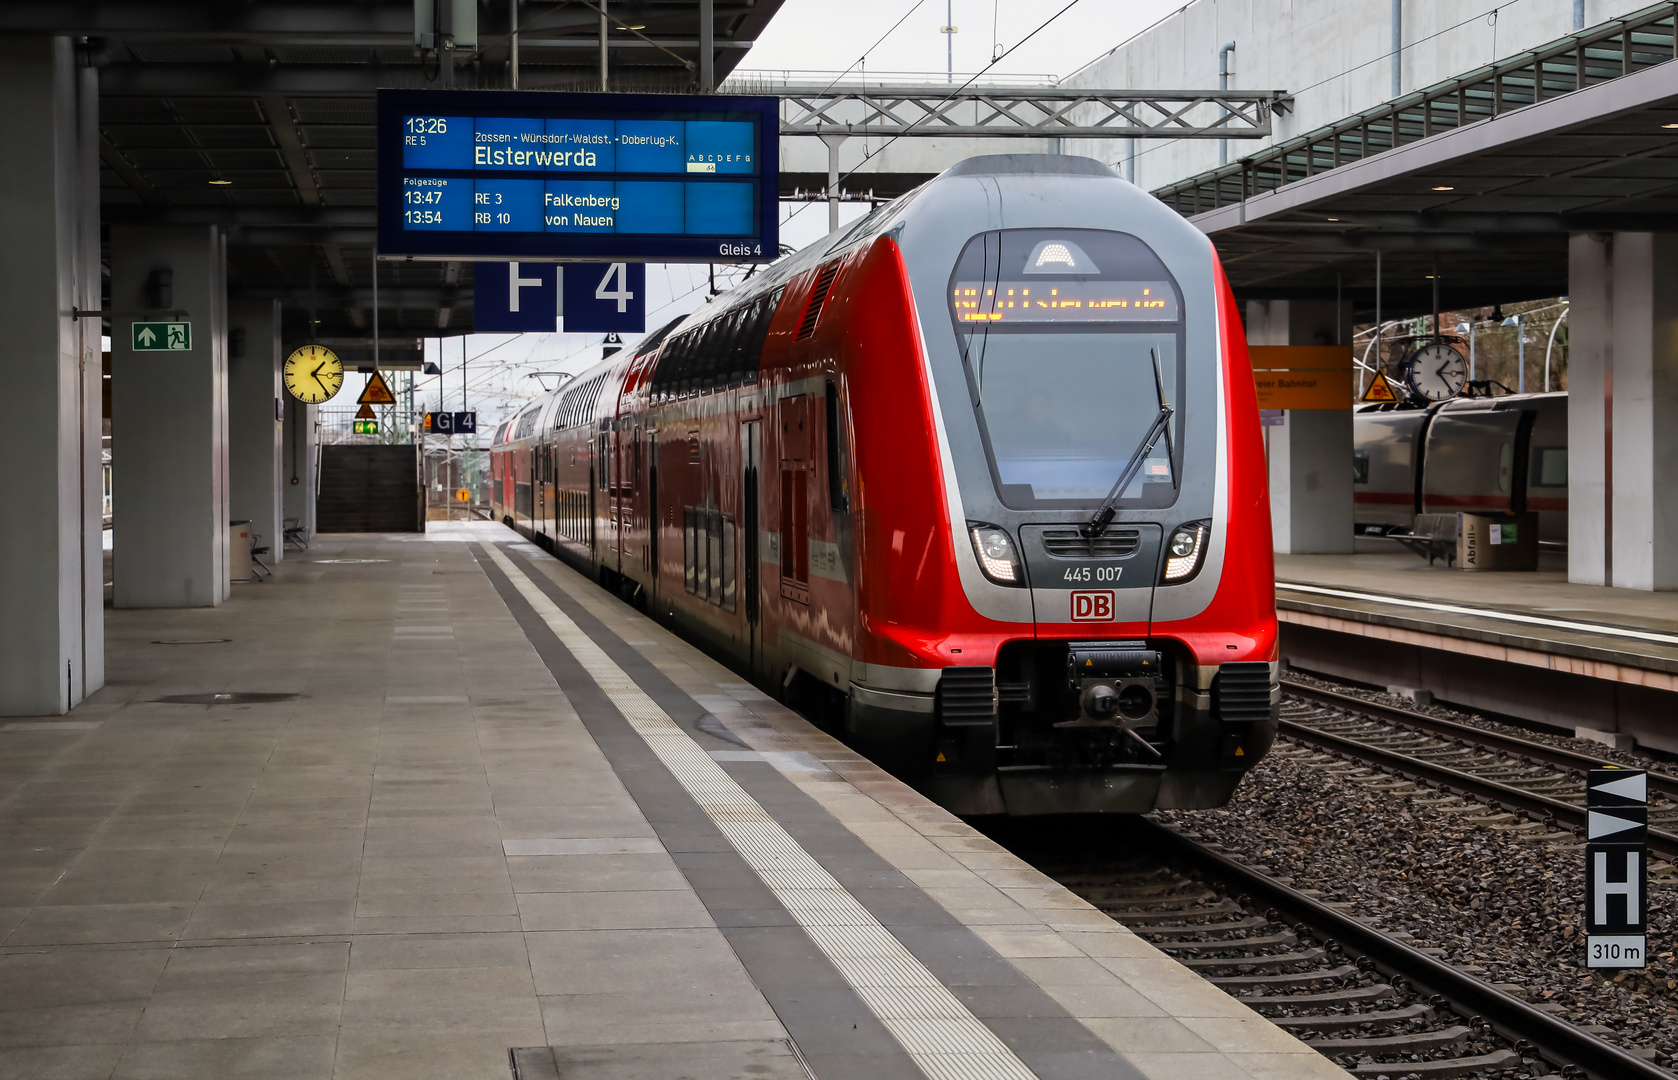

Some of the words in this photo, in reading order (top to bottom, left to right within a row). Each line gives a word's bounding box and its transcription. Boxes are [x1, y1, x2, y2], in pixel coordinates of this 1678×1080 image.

[406, 117, 447, 134] 13:26
[405, 135, 418, 146] RE
[420, 135, 427, 146] 5
[475, 132, 511, 143] Zossen
[520, 133, 612, 145] Wünsdorf-Waldst.
[621, 134, 679, 148] Doberlug-K.
[475, 145, 597, 167] Elsterwerda
[403, 177, 448, 188] Folgezüge
[404, 190, 443, 205] 13:47
[475, 192, 491, 205] RE
[495, 193, 503, 205] 3
[545, 193, 620, 211] Falkenberg
[404, 210, 443, 224] 13:54
[475, 212, 492, 224] RB
[496, 212, 511, 225] 10
[545, 215, 569, 226] von
[574, 212, 614, 227] Nauen
[719, 243, 751, 256] Gleis
[753, 244, 762, 256] 4
[596, 263, 633, 312] 4
[608, 332, 617, 343] 8
[1278, 379, 1317, 389] Bahnhof
[437, 413, 450, 429] G
[462, 413, 474, 429] 4
[1467, 532, 1476, 565] Abfall
[1063, 567, 1091, 582] 445
[1096, 566, 1123, 582] 007
[1075, 595, 1111, 618] DB
[1594, 852, 1640, 925] H
[1593, 944, 1620, 959] 310
[1624, 946, 1640, 959] m
